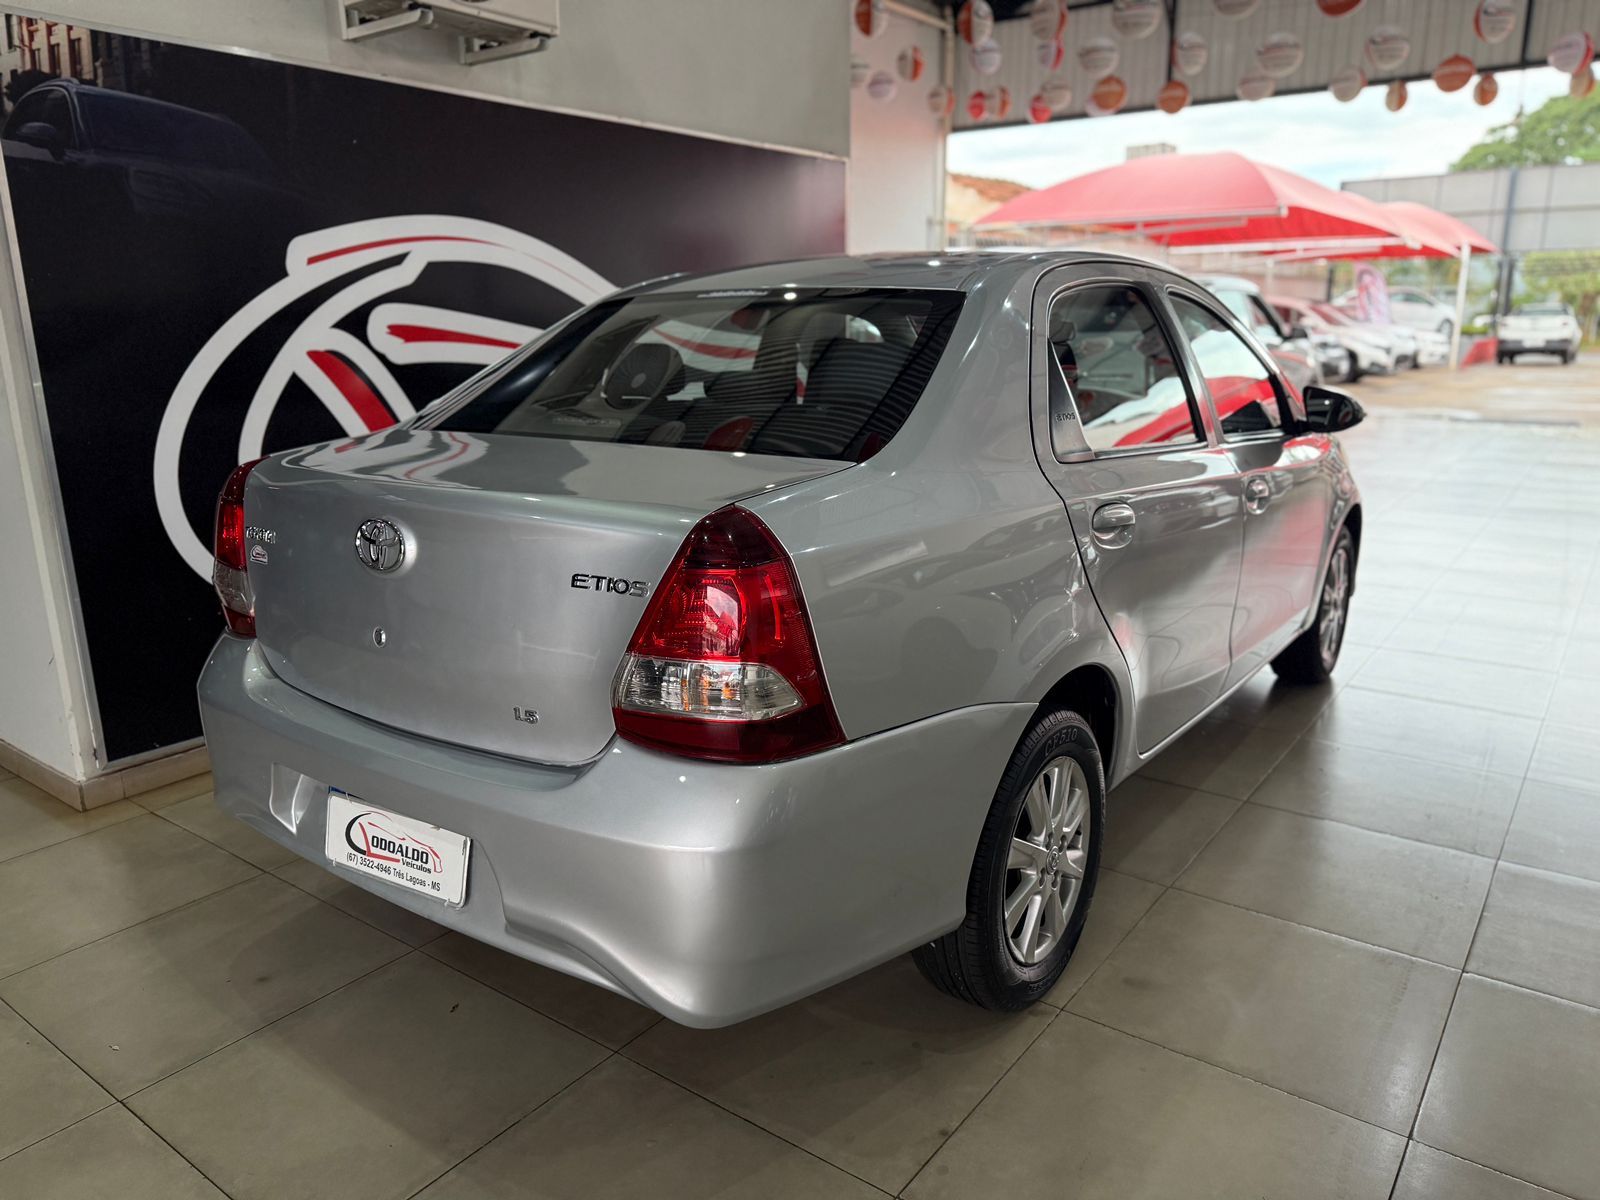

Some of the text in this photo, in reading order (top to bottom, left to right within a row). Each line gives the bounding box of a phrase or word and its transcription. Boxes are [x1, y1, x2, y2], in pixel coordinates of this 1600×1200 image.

[570, 573, 651, 598] ETIOS
[346, 851, 359, 866] (67)
[359, 856, 392, 876] 3522-4946
[405, 872, 427, 886] Lagoas
[431, 880, 442, 892] MS
